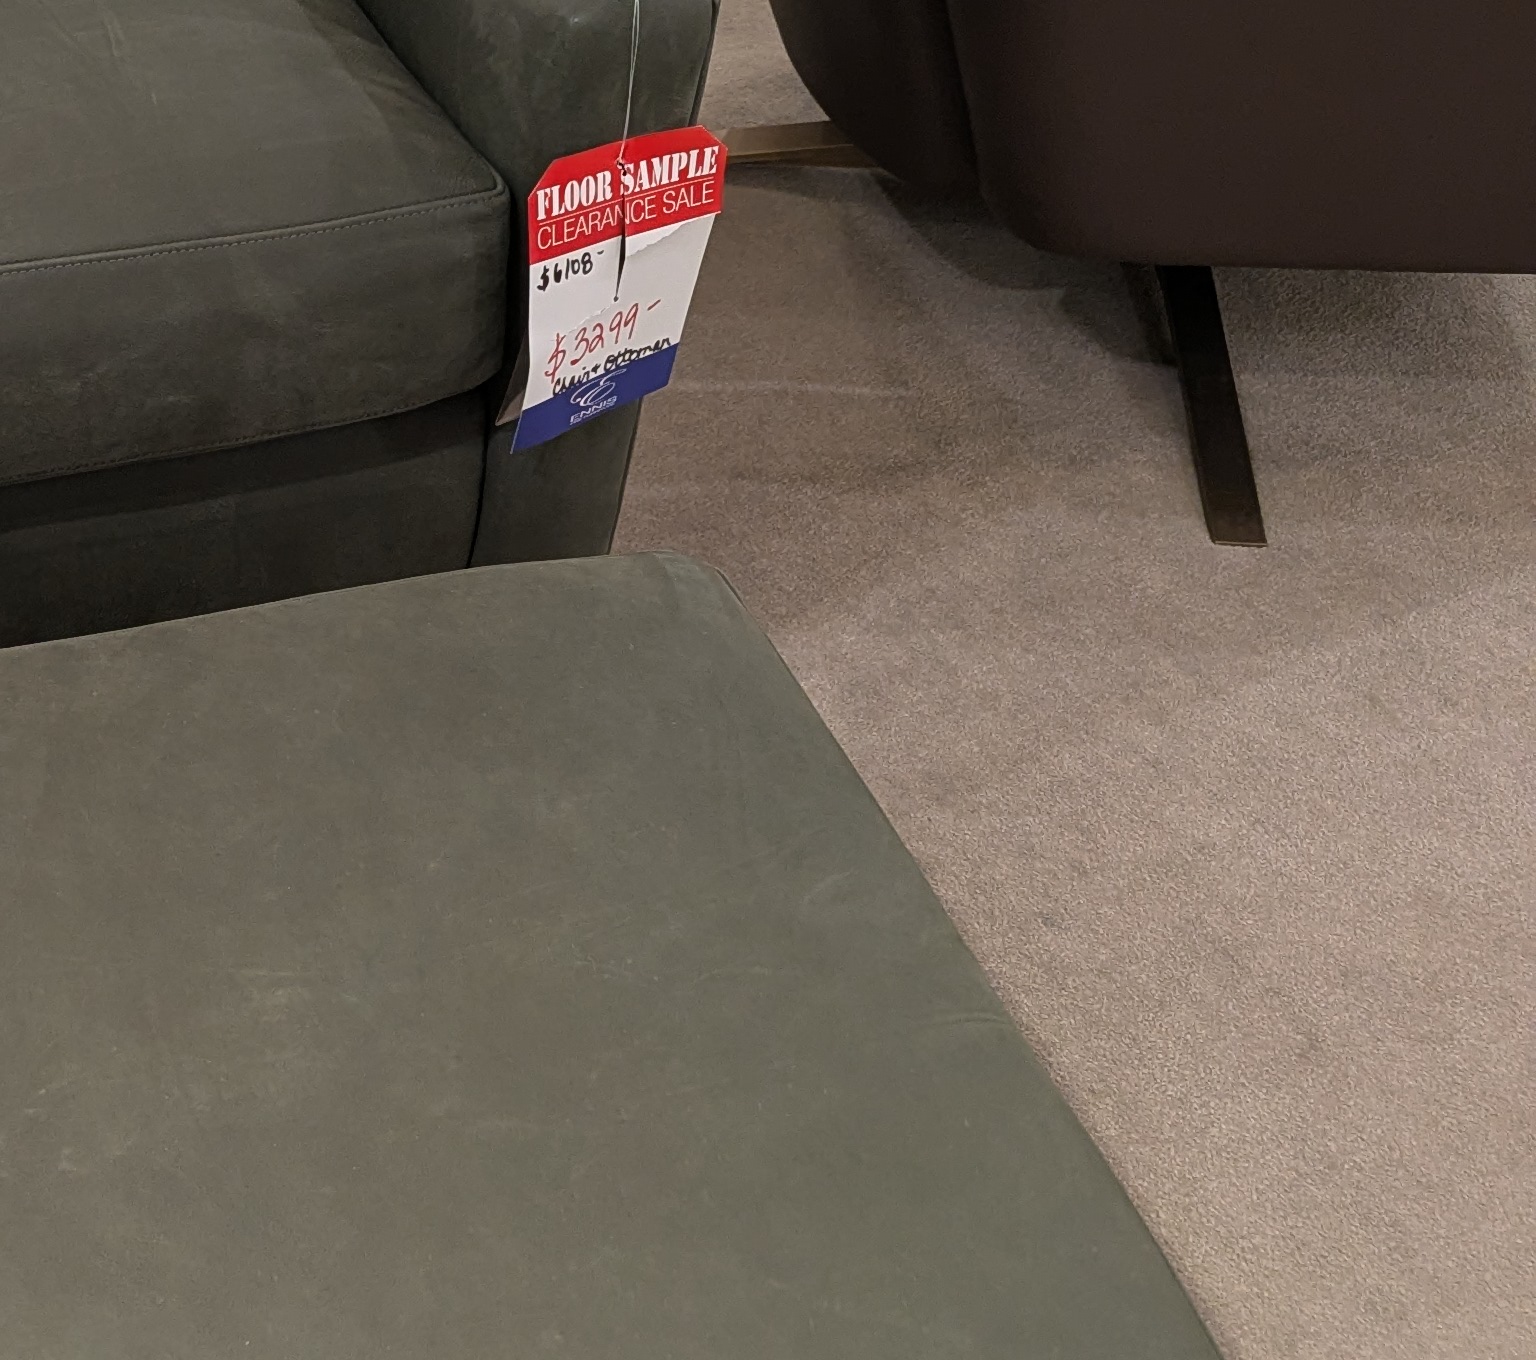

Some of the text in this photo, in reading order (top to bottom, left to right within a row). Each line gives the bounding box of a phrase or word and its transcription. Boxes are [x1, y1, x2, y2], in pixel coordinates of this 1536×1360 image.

[537, 146, 719, 221] FLOOR SAMPLE
[537, 180, 715, 250] CLEARANCE SALE
[570, 395, 618, 424] ENNIS
